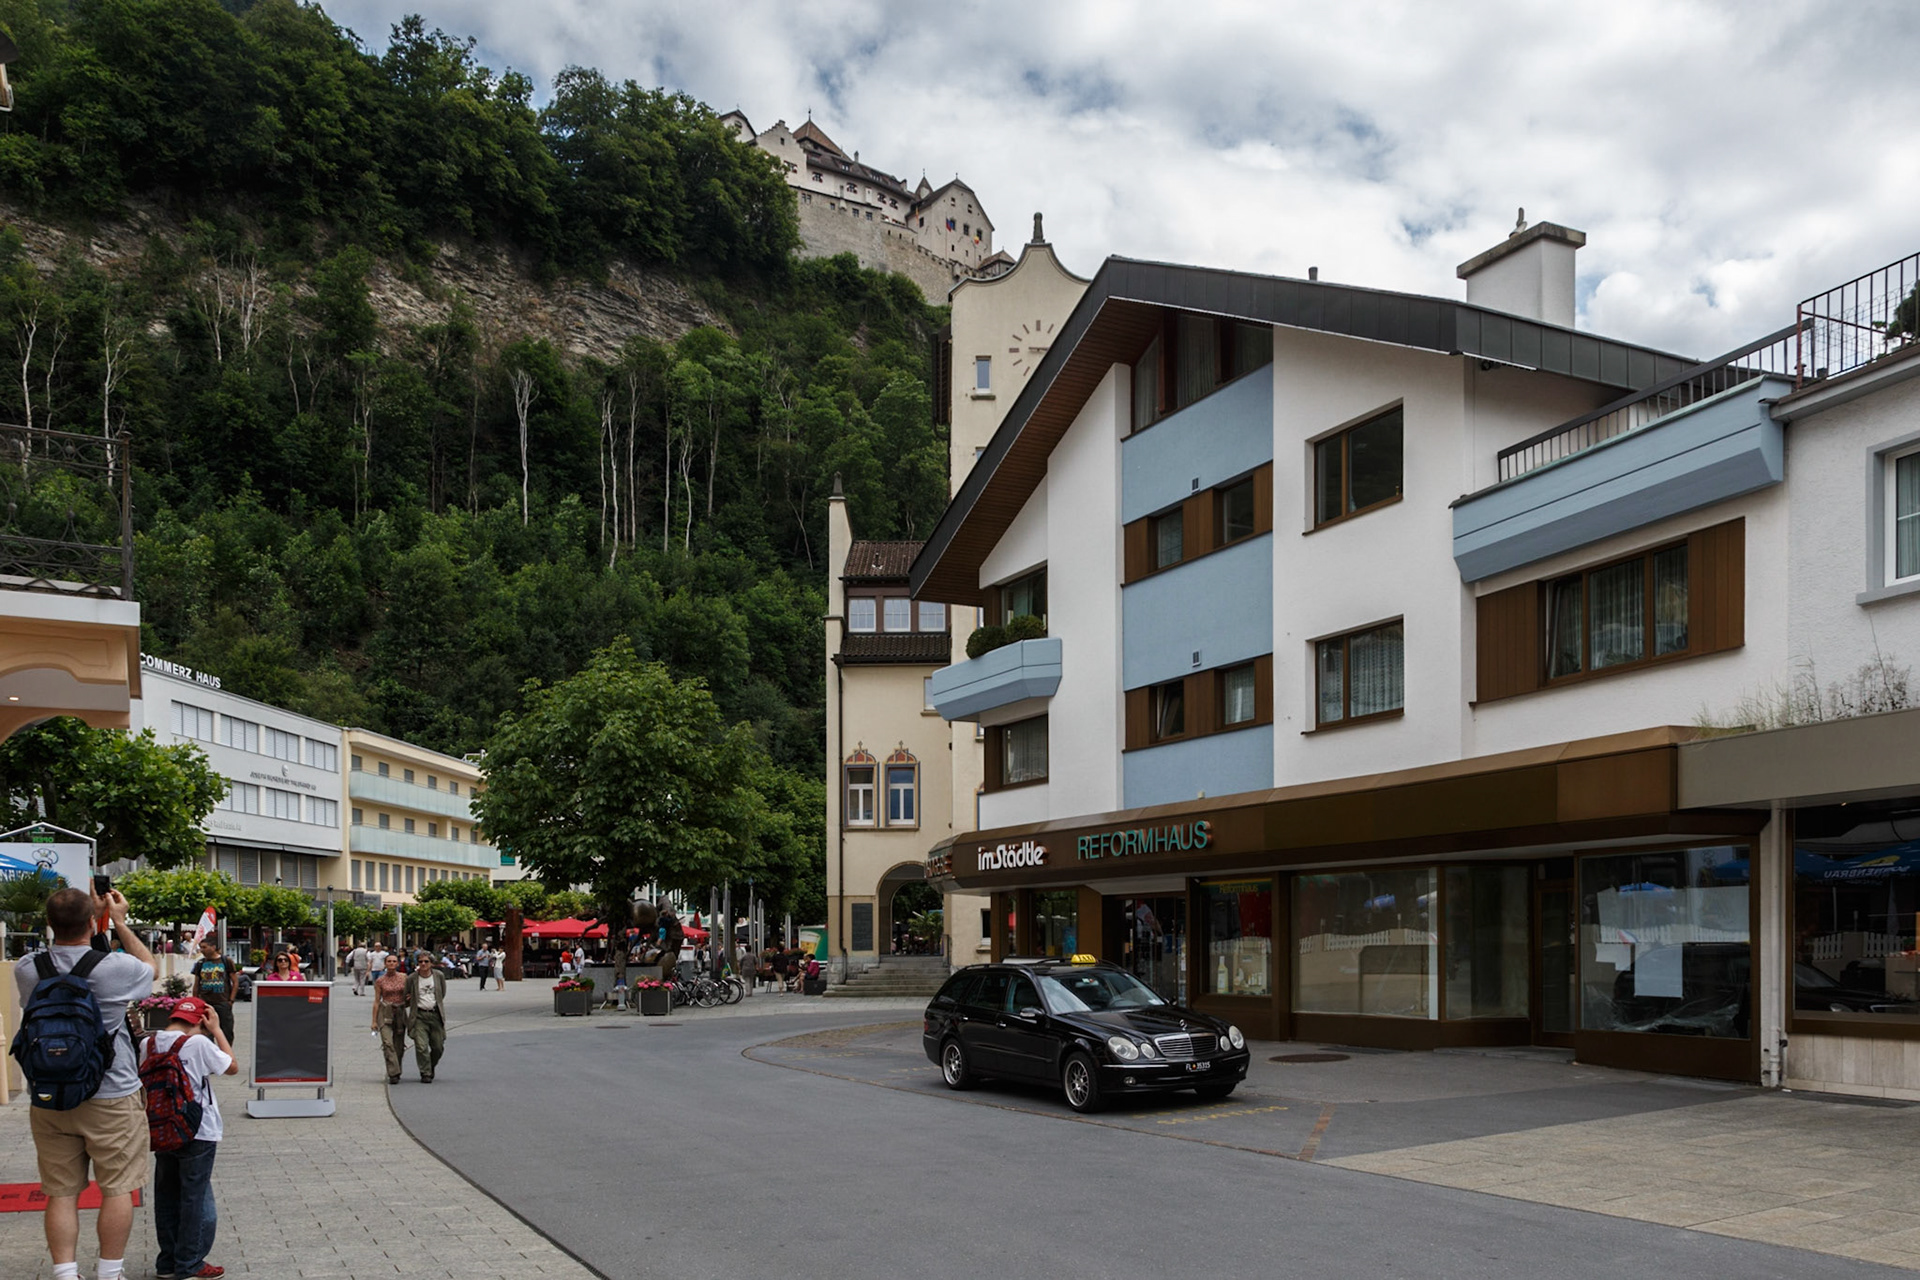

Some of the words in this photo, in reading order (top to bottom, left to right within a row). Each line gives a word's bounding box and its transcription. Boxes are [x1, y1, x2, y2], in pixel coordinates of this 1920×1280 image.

[139, 652, 192, 680] COMMERZ
[196, 671, 221, 689] HAUS
[1077, 820, 1212, 861] REFORMHAUS
[1078, 955, 1096, 964] TAXI
[1185, 1063, 1193, 1071] FL
